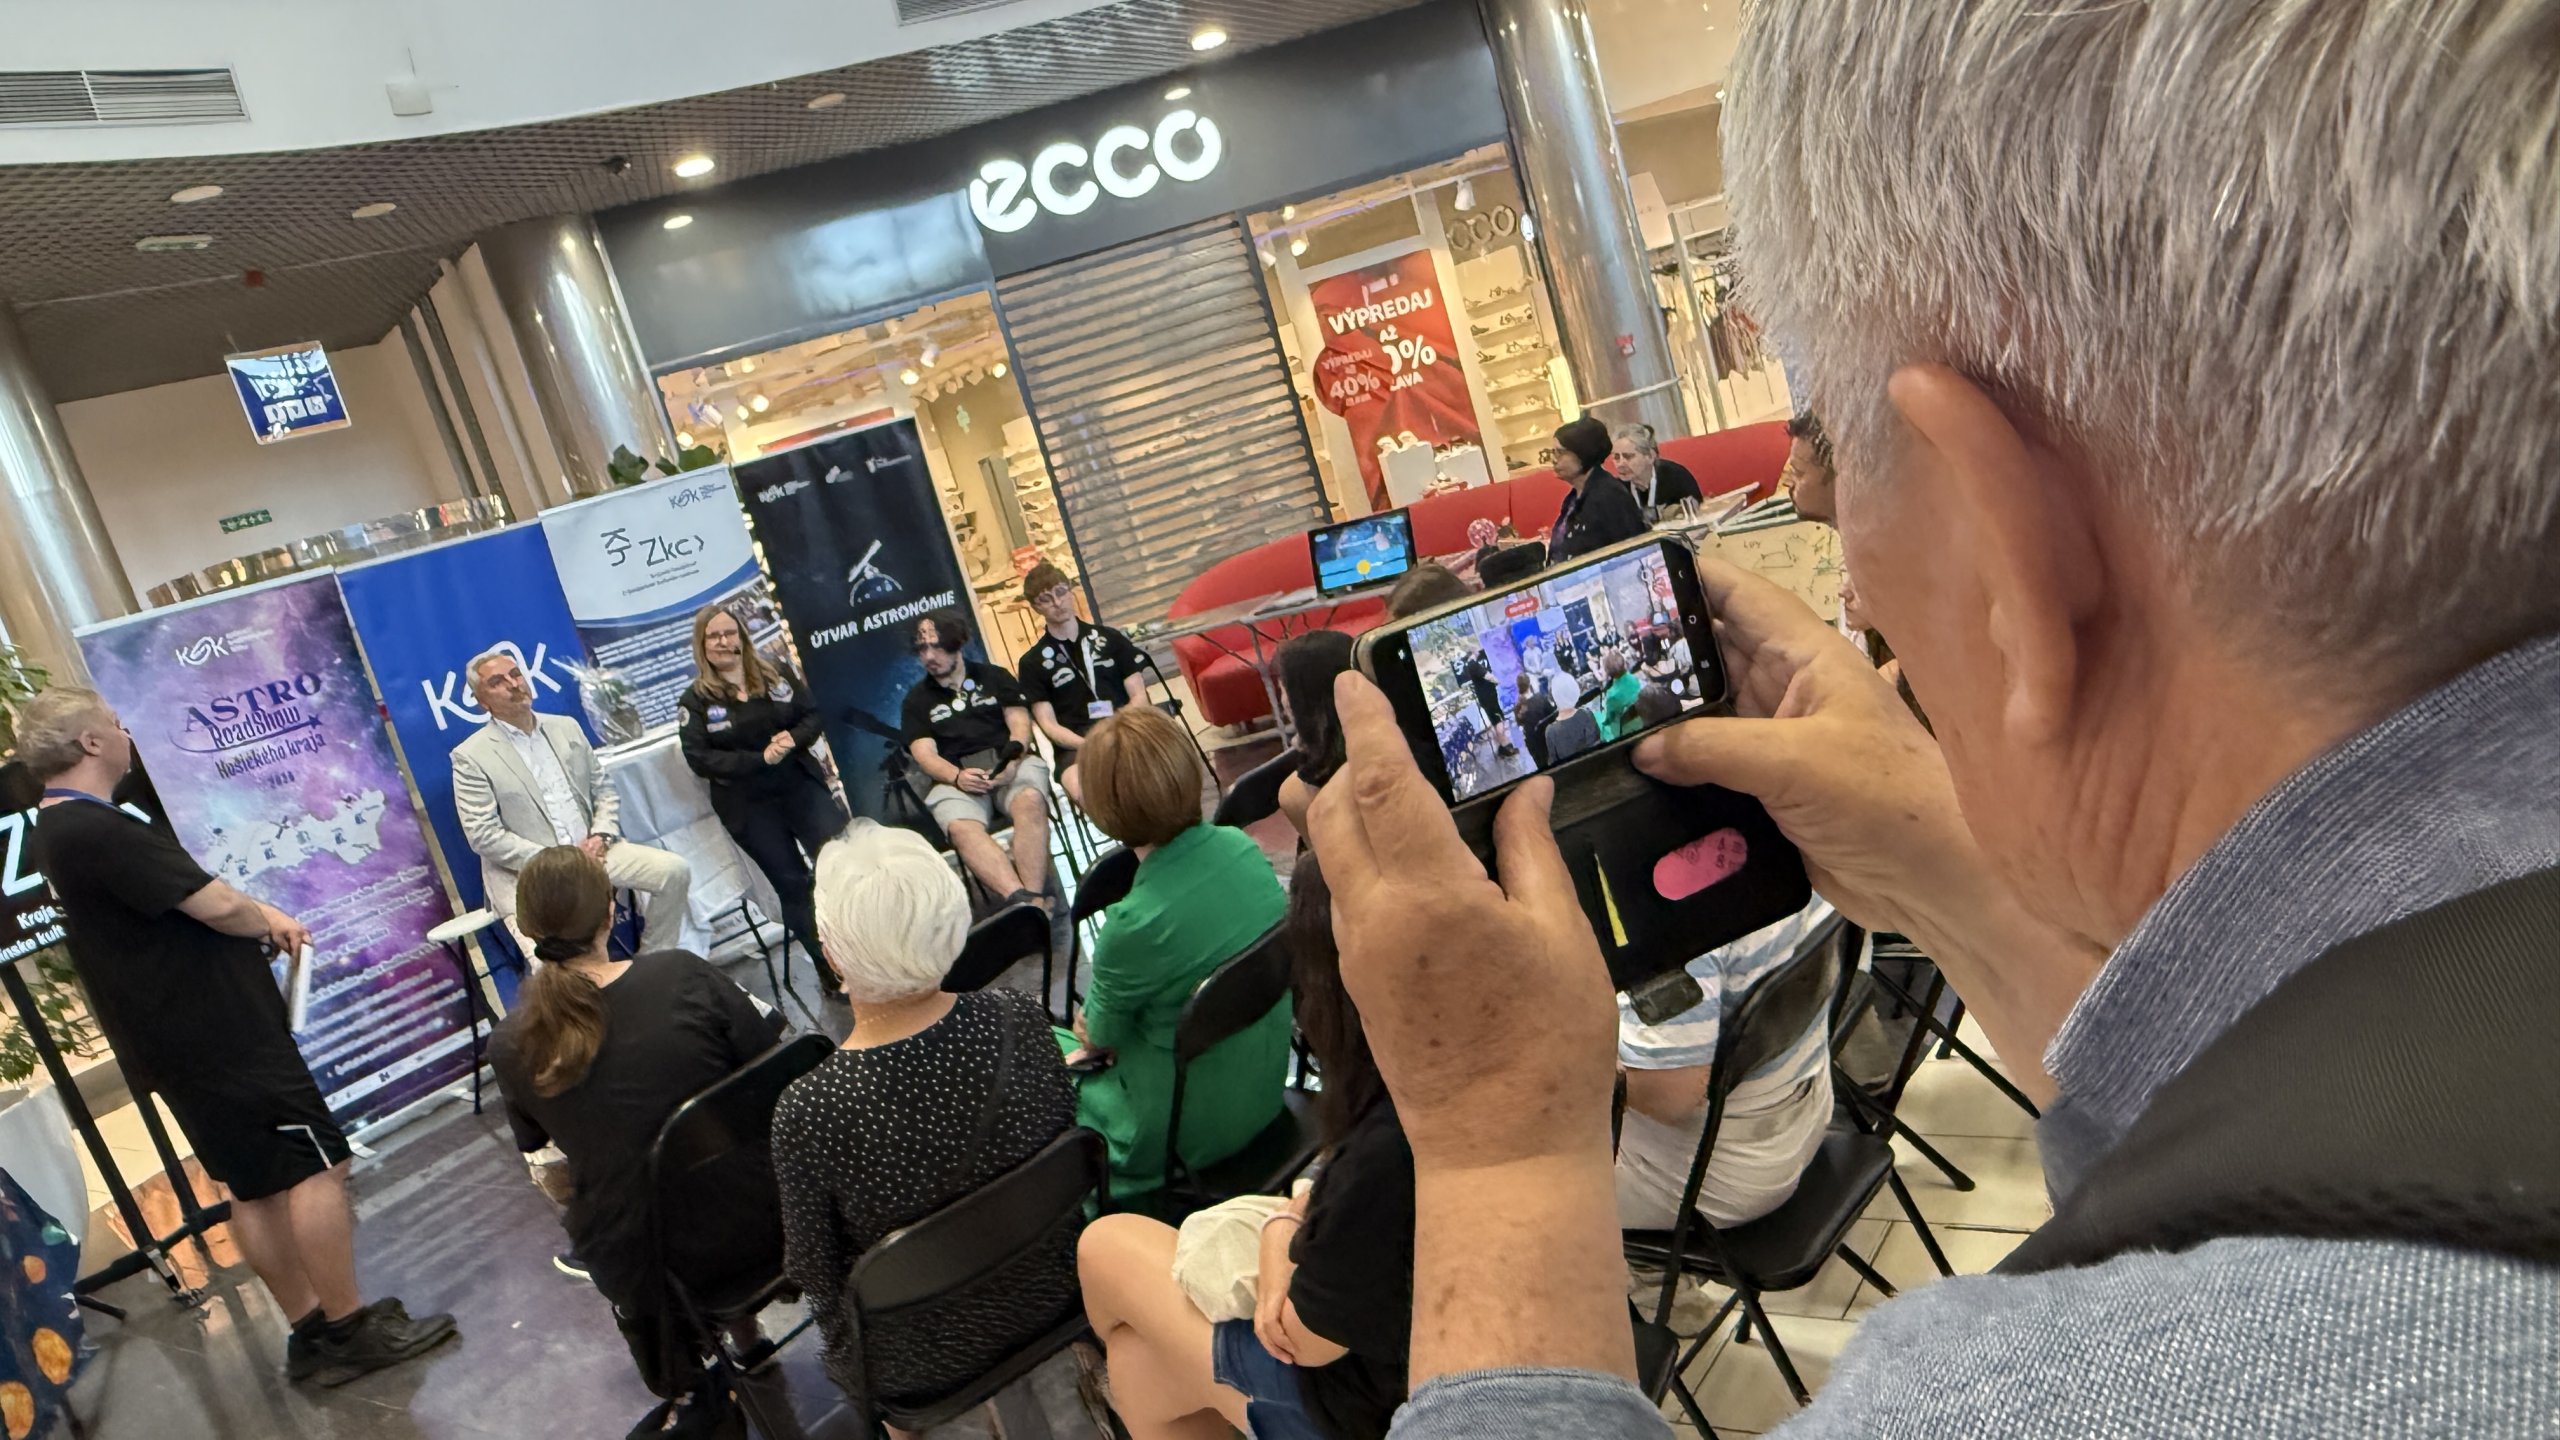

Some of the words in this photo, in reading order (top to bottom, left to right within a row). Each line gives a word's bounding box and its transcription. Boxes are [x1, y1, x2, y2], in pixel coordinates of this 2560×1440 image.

[968, 109, 1222, 233] ecco
[1446, 204, 1517, 250] cco
[1328, 288, 1434, 335] VÝPREDAJ
[1383, 334, 1437, 375] 0%
[1329, 371, 1381, 399] 40%
[1389, 371, 1424, 392] AVA
[810, 619, 859, 649] ÚTVAR
[863, 590, 956, 631] ASTRONÓMIE
[185, 672, 322, 733] ASTRO
[208, 705, 302, 749] RoadShow
[286, 731, 327, 756] kraja
